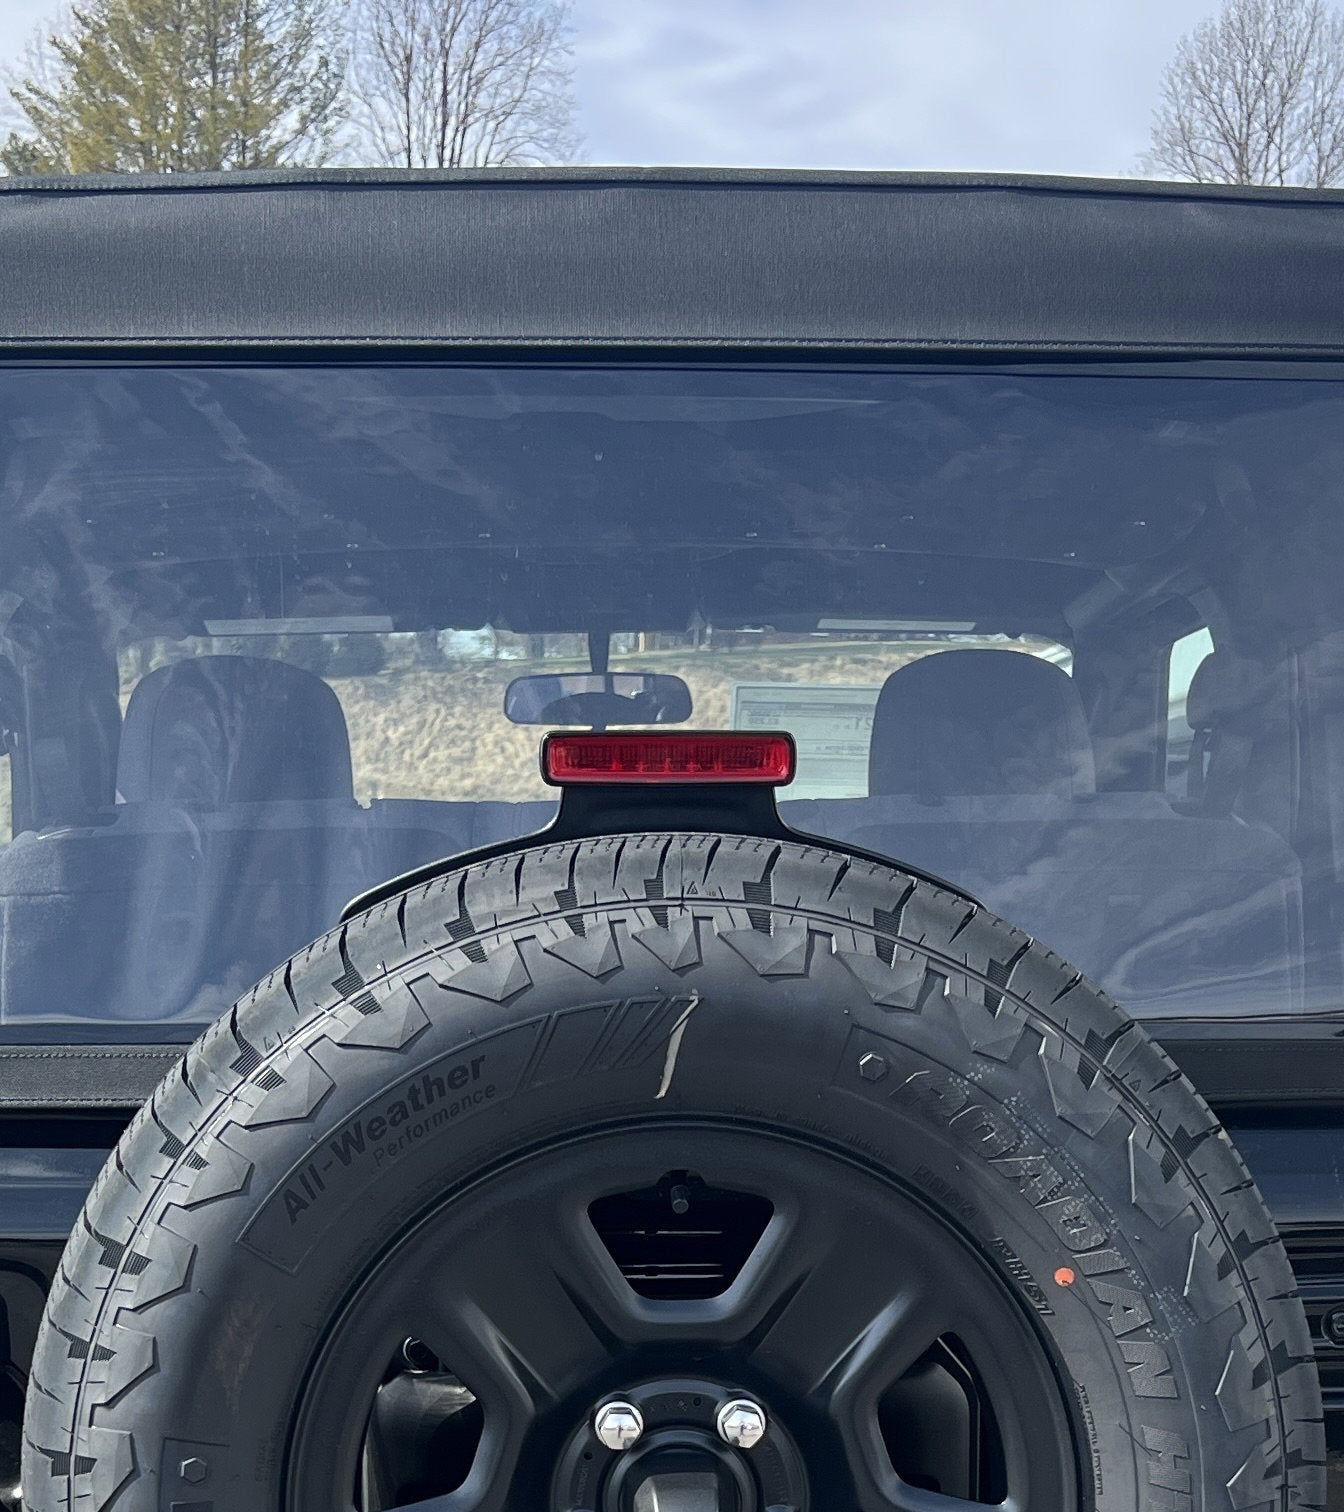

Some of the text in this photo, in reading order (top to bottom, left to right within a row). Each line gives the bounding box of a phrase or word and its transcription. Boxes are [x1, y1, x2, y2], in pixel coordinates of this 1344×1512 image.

[280, 1048, 489, 1226] All-Weather
[370, 1080, 498, 1169] Performance
[890, 1066, 1178, 1399] ROADIAN
